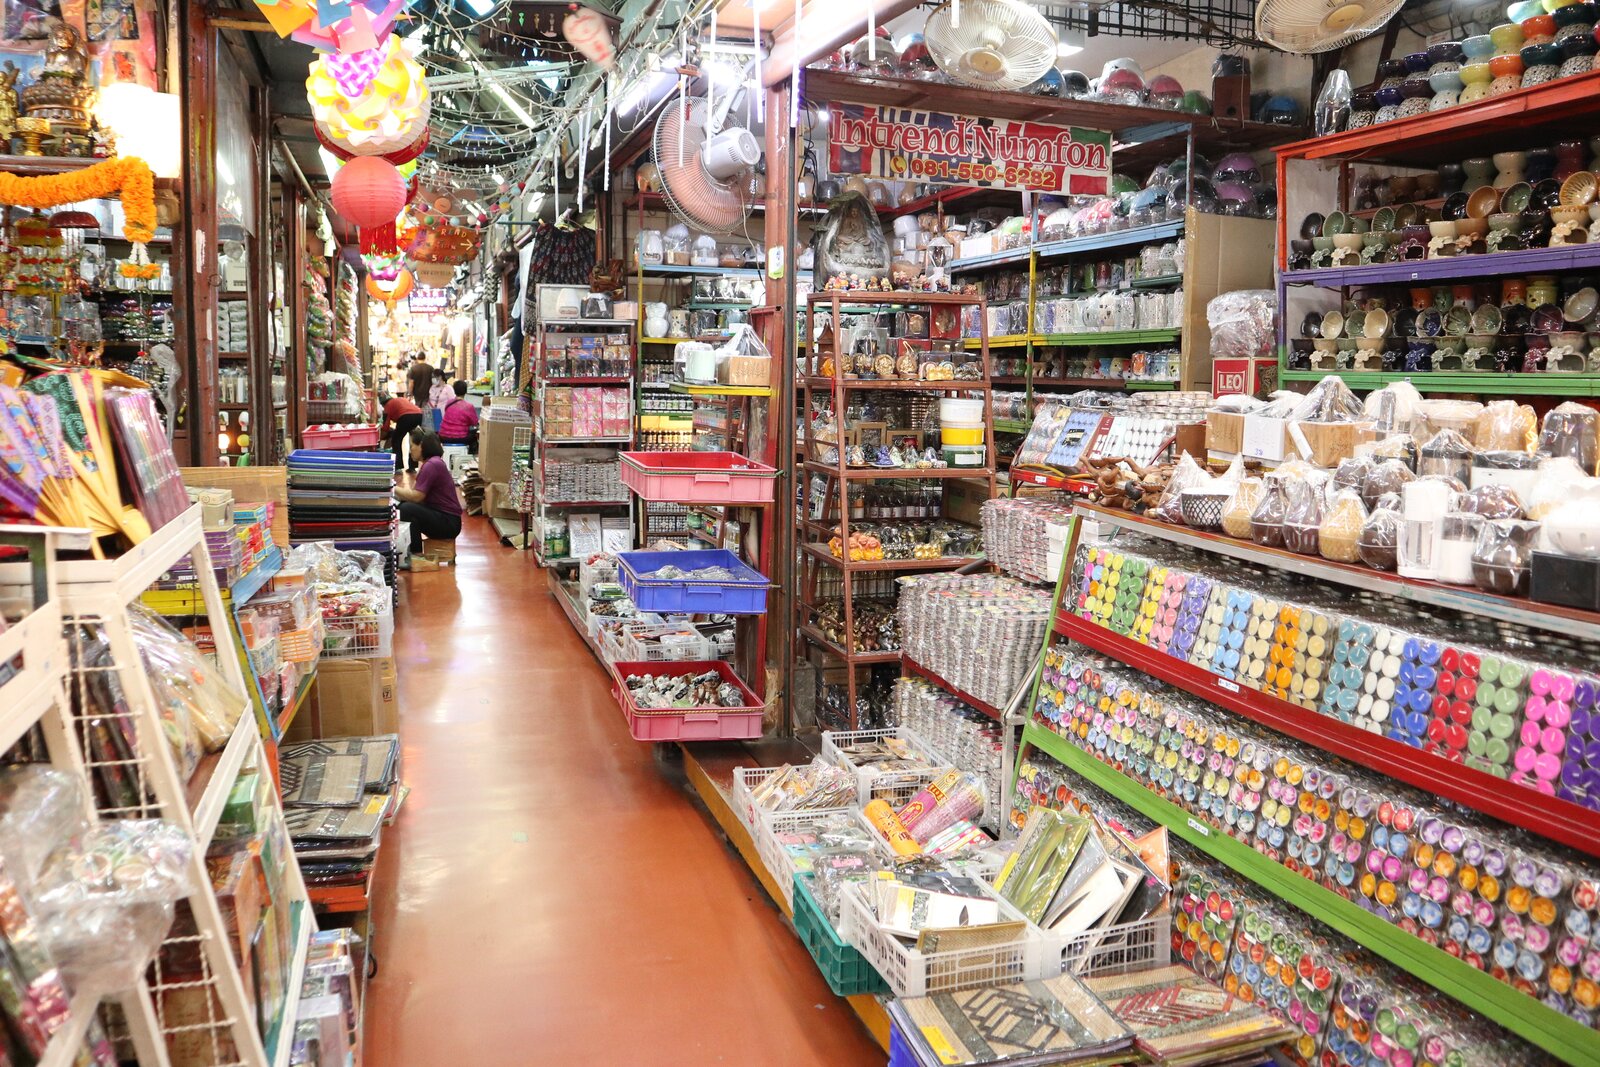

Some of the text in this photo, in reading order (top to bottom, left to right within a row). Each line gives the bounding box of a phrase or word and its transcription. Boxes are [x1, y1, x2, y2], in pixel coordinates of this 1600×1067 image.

[831, 110, 1109, 171] Intrend Numfon
[911, 158, 1056, 187] 081-550-6282
[1219, 374, 1243, 391] LEO
